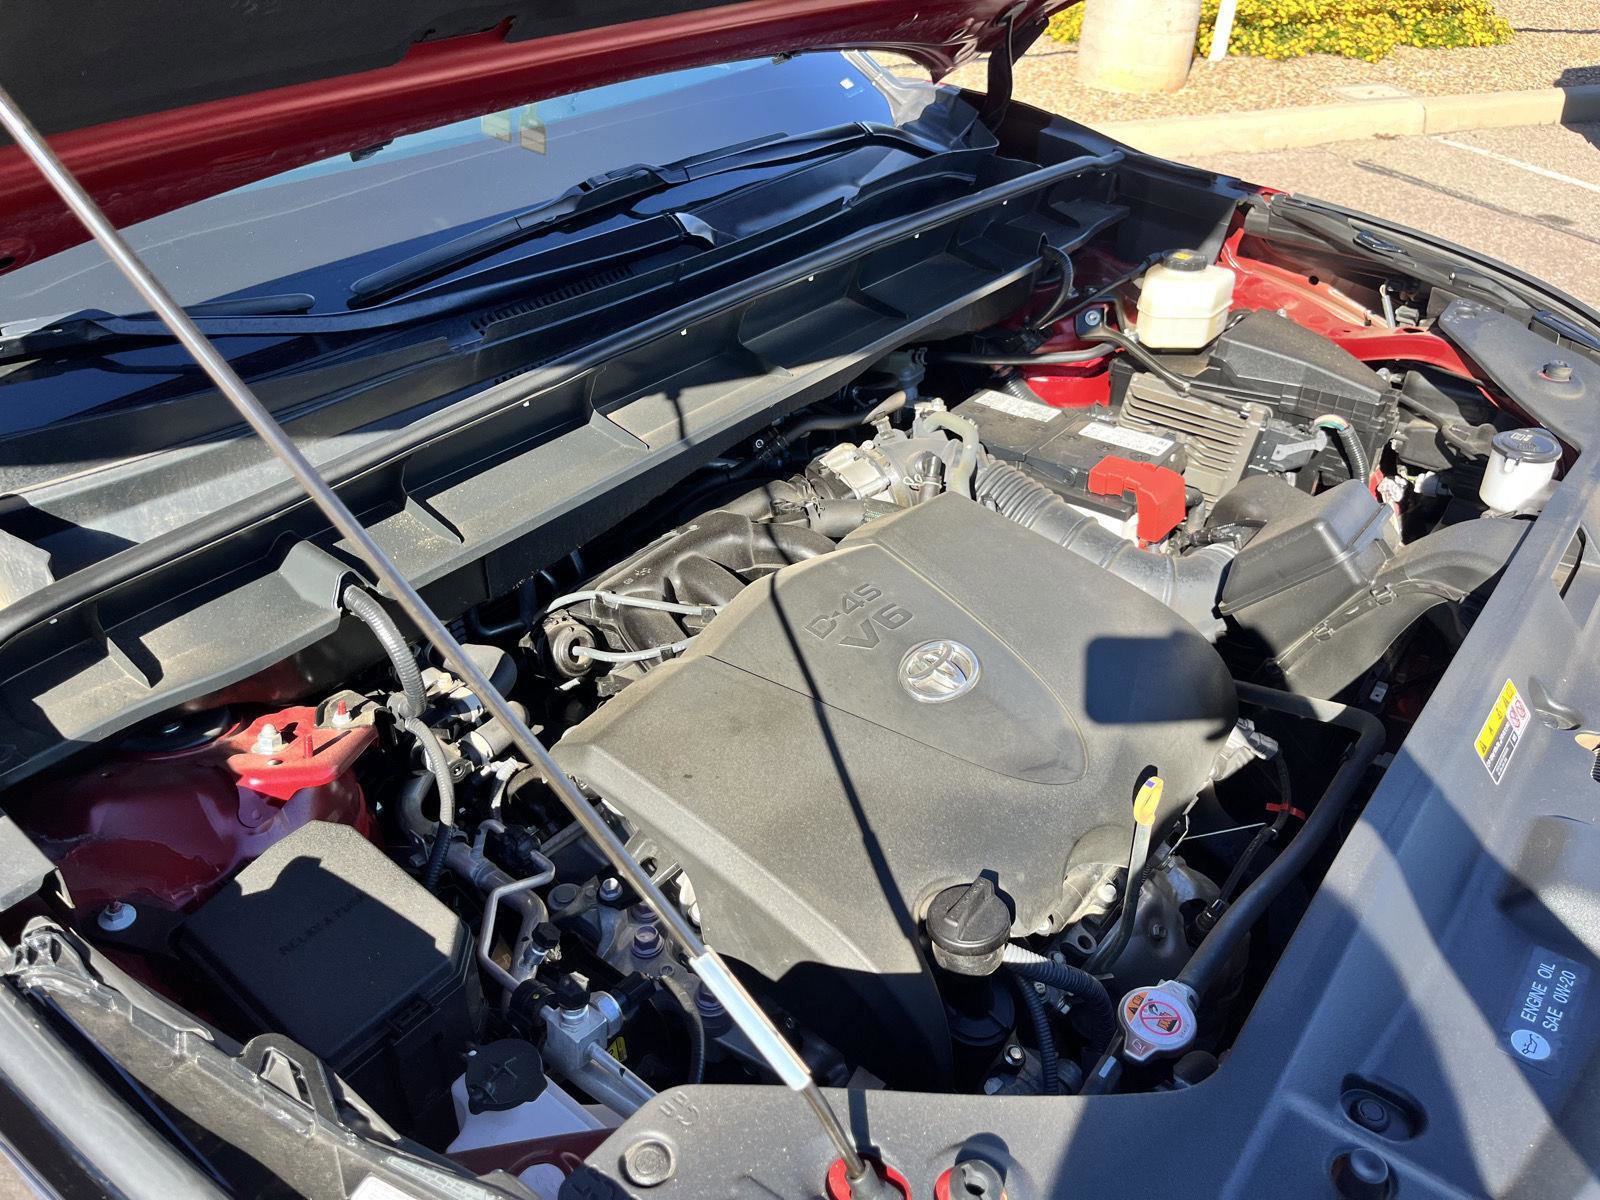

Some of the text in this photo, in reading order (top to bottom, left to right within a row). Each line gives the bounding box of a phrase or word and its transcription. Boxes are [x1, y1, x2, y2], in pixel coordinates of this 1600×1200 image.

[803, 583, 883, 640] D-4S
[838, 602, 914, 650] V6
[1521, 963, 1556, 1023] ENGINE OIL
[1542, 970, 1576, 1032] SAE 0W-20
